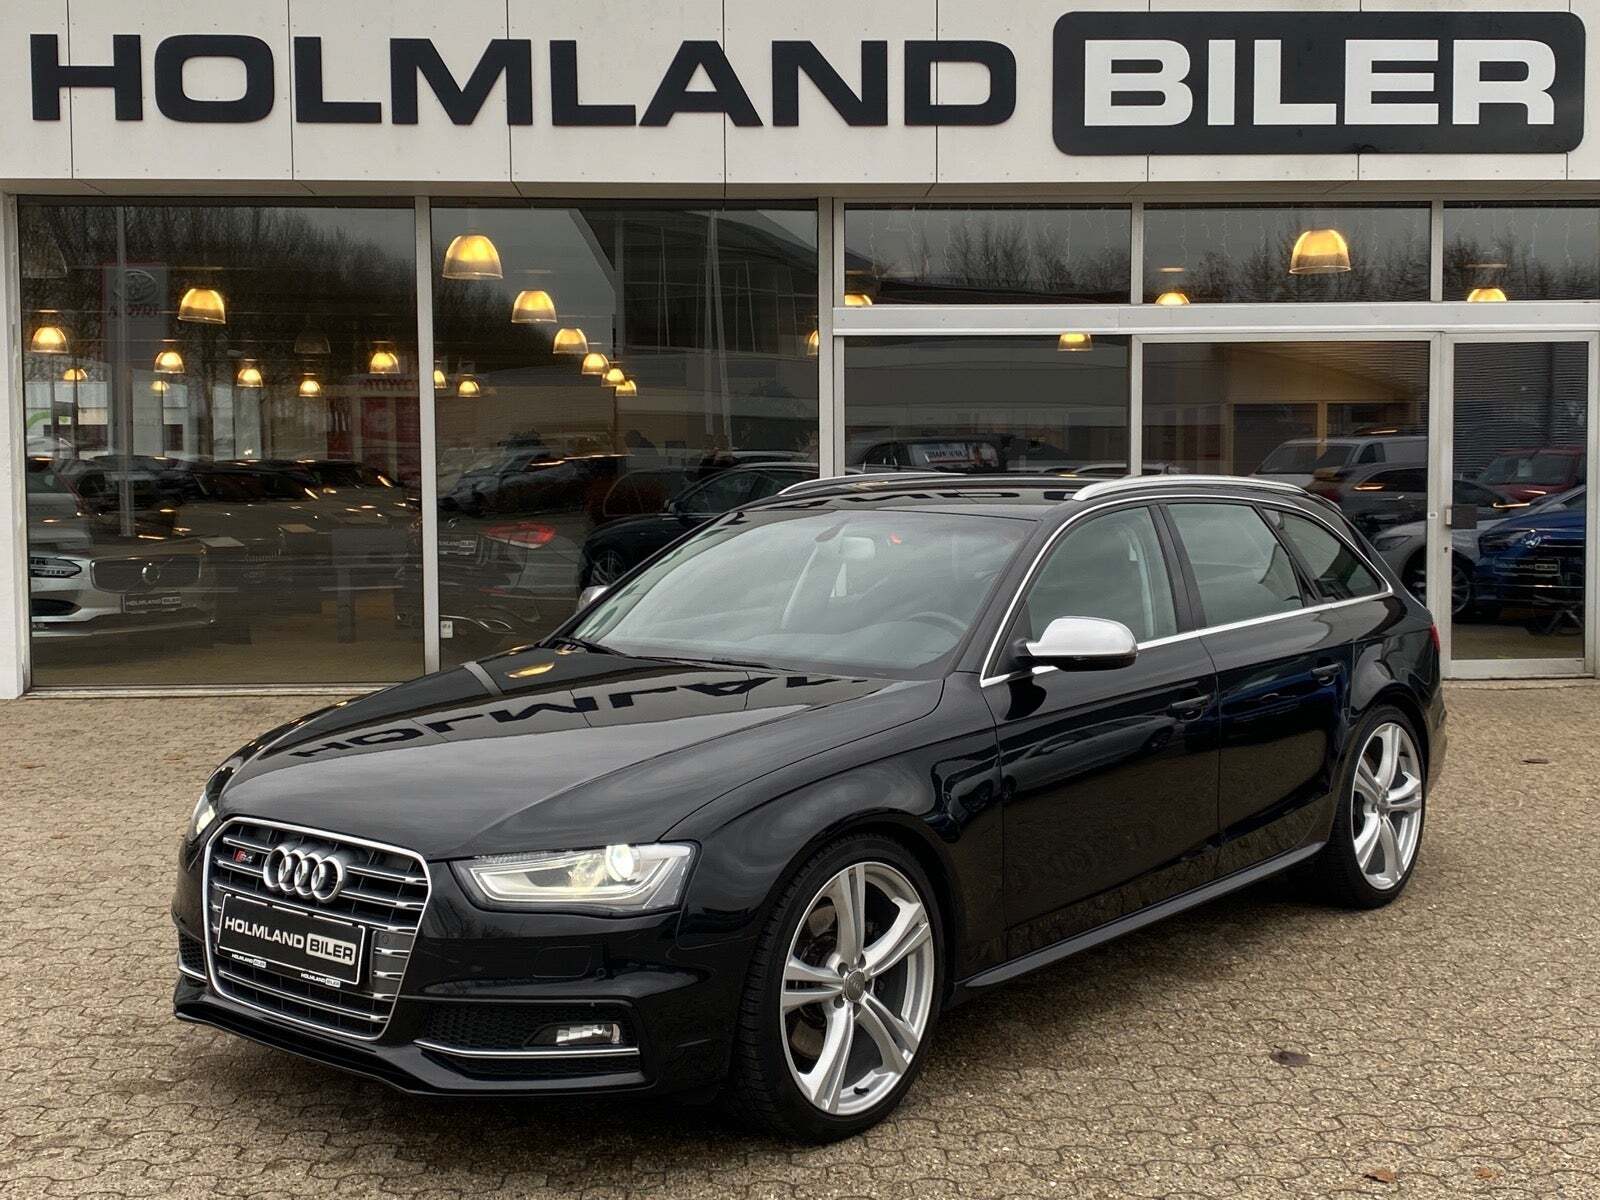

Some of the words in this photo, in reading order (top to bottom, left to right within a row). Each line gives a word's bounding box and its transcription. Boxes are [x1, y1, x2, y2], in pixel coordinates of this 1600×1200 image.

[30, 34, 1017, 127] HOLMLAND
[1084, 39, 1556, 126] BILER
[224, 916, 305, 949] HOLMLAND
[308, 938, 354, 961] BILER
[231, 952, 254, 964] HOLMLAND
[300, 972, 326, 983] HOLMLAND
